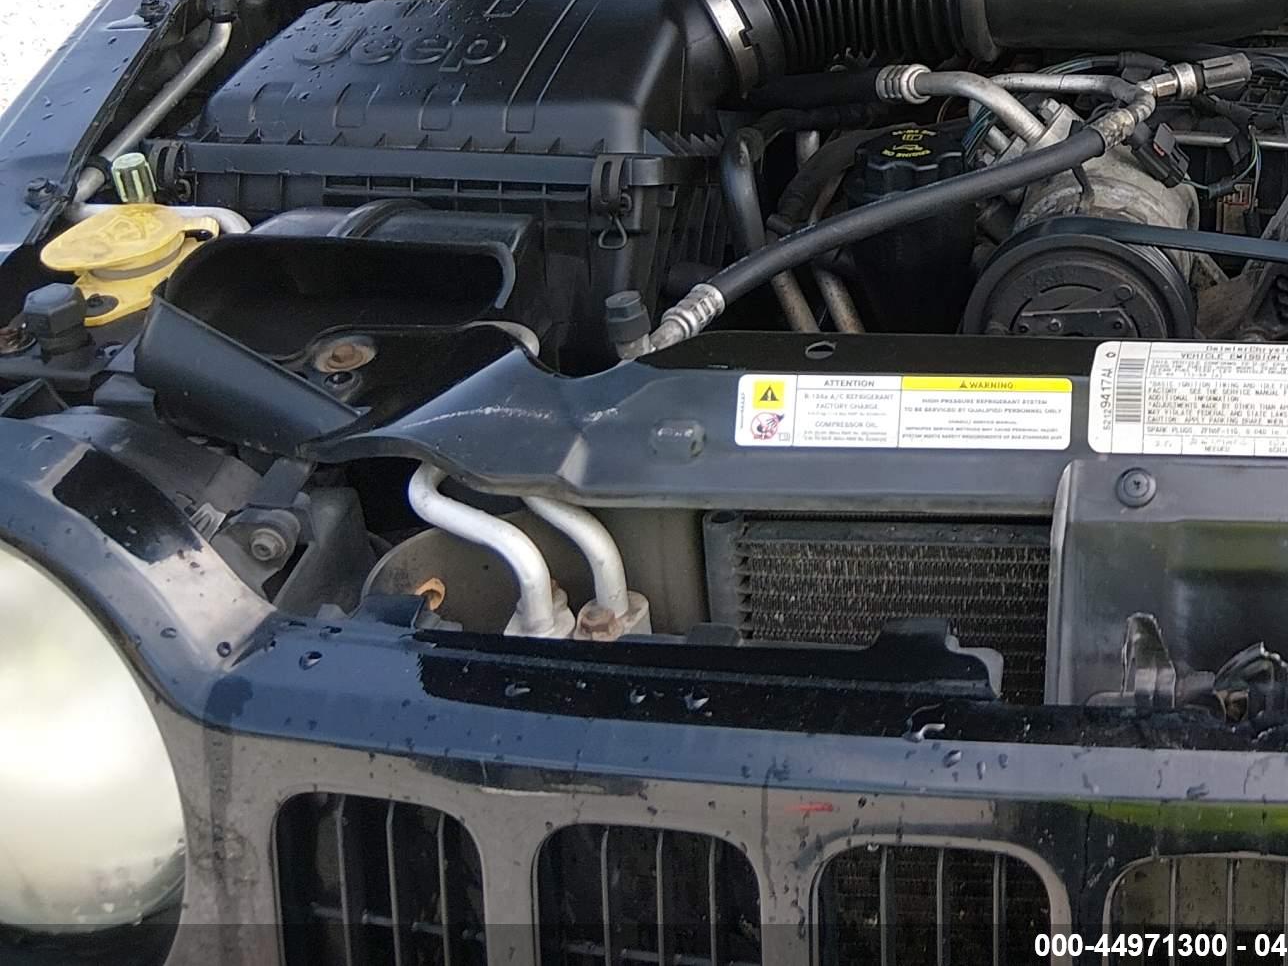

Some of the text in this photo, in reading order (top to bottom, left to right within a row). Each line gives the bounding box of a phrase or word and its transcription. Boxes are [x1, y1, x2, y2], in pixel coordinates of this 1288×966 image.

[292, 27, 507, 73] Jeep
[824, 379, 875, 387] ATTENTION
[969, 381, 1014, 390] WARNING
